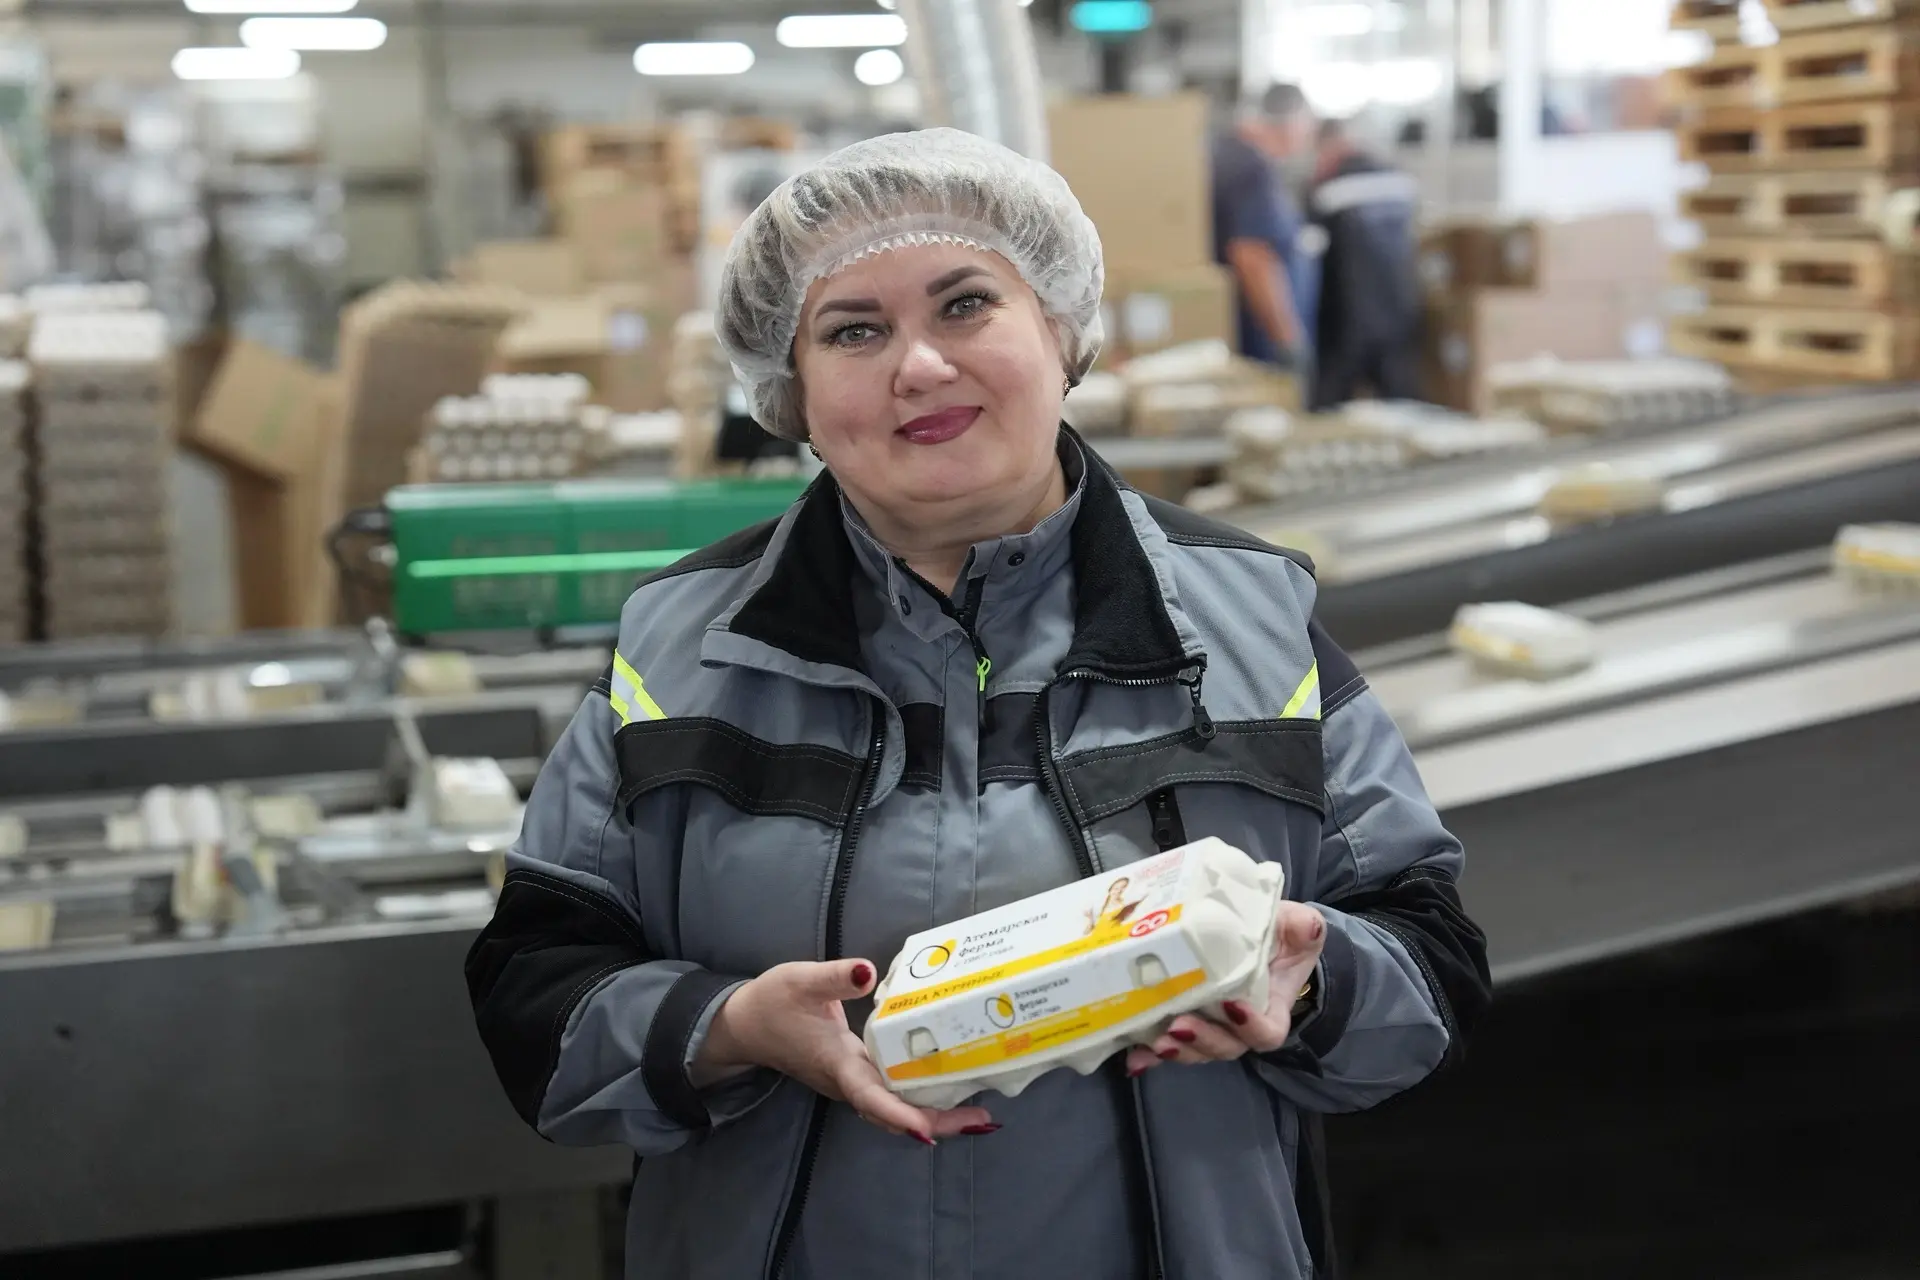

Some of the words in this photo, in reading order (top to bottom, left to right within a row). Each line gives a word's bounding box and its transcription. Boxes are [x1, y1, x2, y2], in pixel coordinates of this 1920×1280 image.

[963, 913, 1048, 944] Атемарская
[959, 938, 1004, 957] ферма
[1015, 977, 1069, 999] Атемарская
[1019, 997, 1048, 1011] ферма
